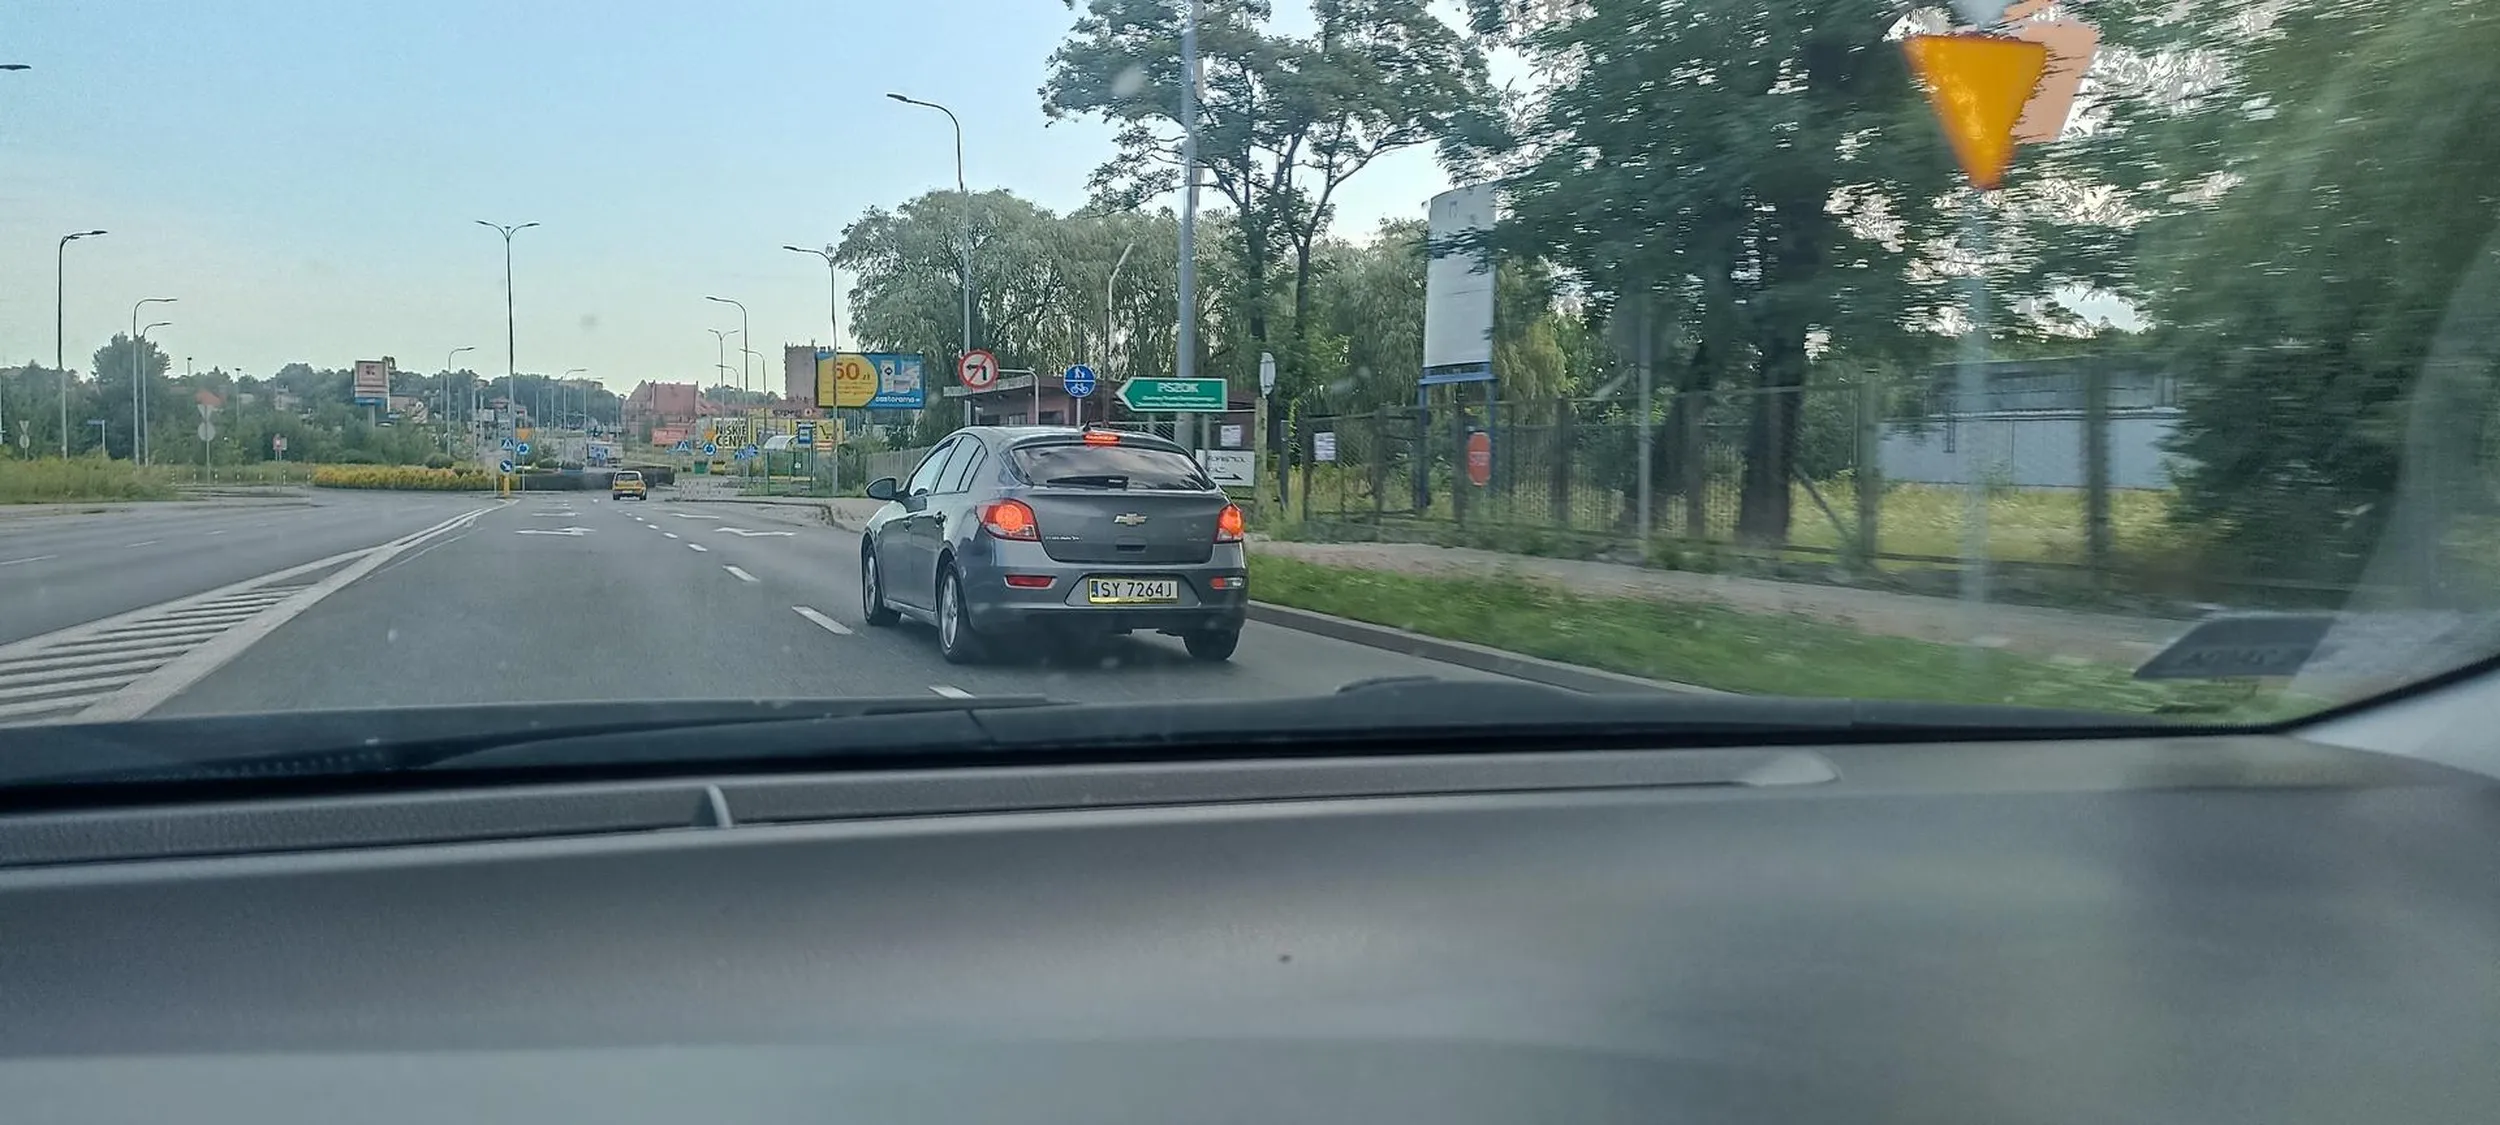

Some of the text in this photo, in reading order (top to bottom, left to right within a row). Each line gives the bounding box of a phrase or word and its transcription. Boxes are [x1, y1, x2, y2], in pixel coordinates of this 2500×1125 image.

[716, 425, 747, 435] NISKIE
[1101, 582, 1120, 598] SY
[1127, 582, 1171, 597] 7264J
